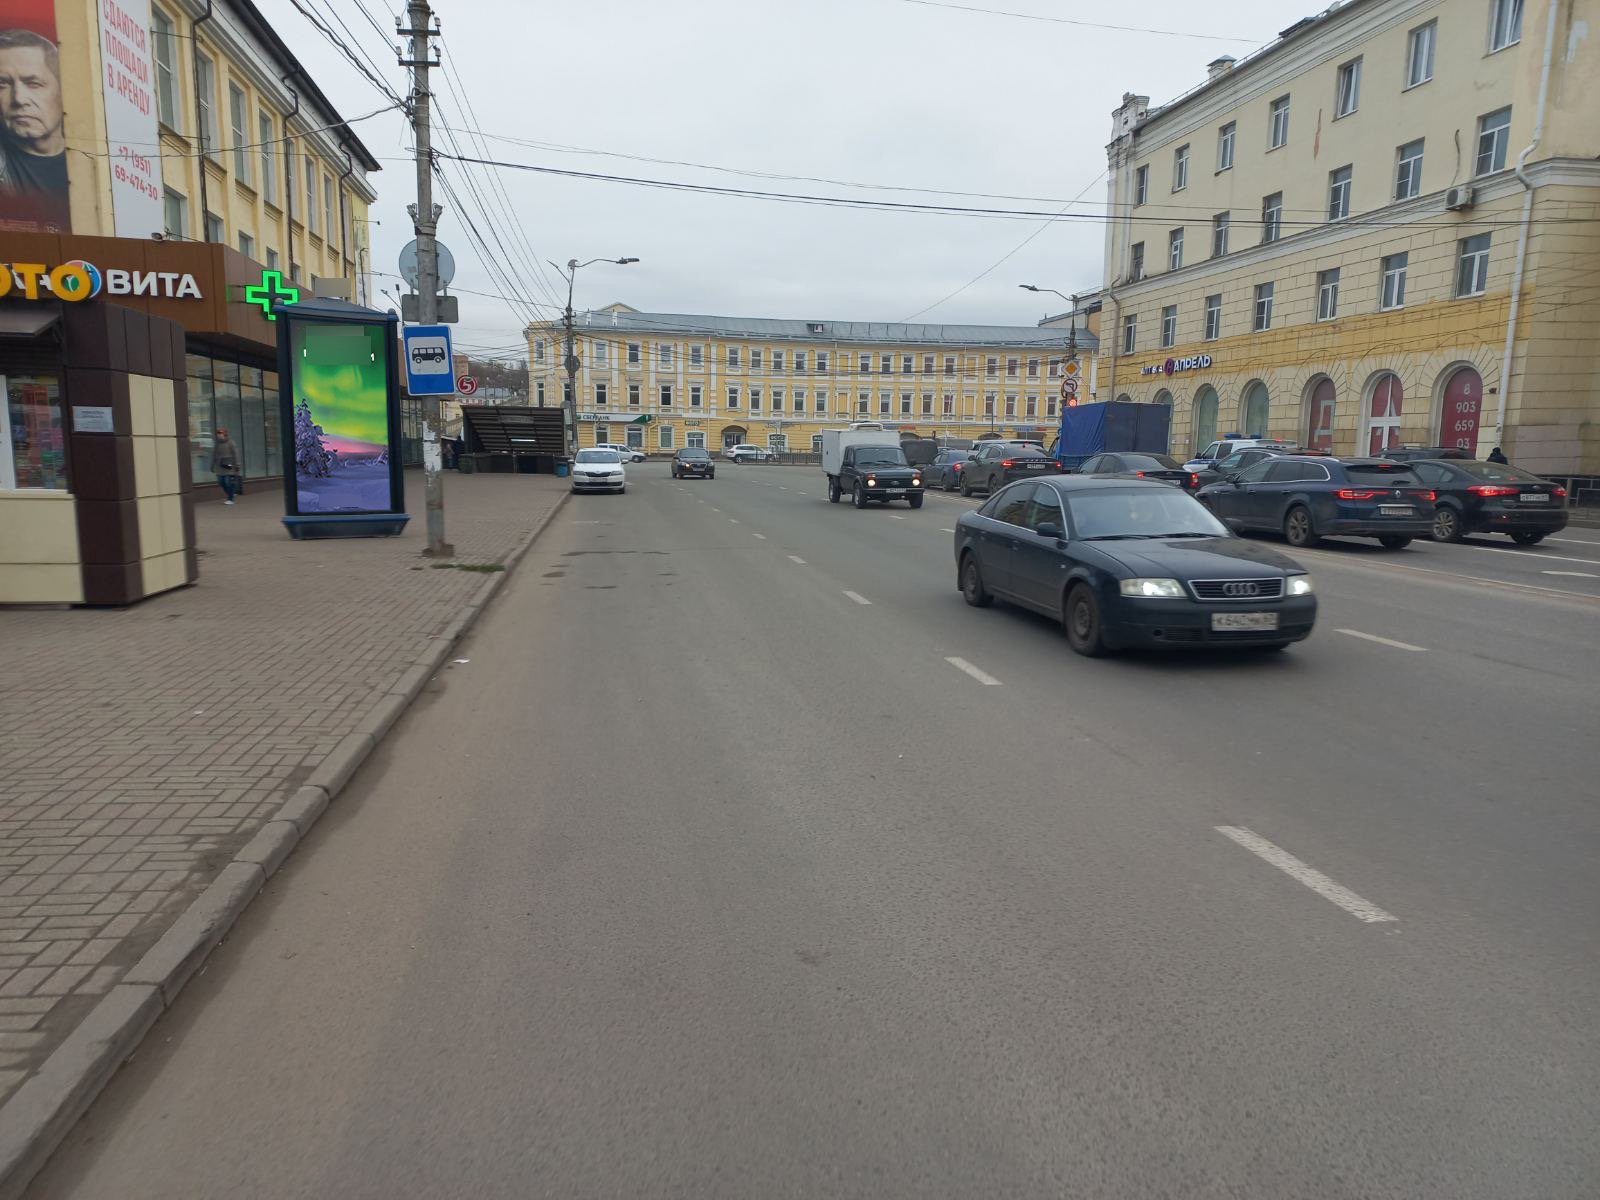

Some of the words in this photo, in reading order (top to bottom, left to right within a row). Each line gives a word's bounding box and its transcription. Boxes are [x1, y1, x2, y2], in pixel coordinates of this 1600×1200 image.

[102, 0, 146, 53] СДАЮТСЯ
[105, 28, 148, 85] ПЛОЩАДИ
[108, 63, 114, 88] В
[117, 71, 150, 116] АРЕНДУ
[118, 145, 129, 161] +7
[131, 149, 151, 177] (951)
[115, 164, 158, 200] 69-474-30
[106, 269, 203, 299] ВИТА
[1463, 383, 1471, 395] 8
[1456, 401, 1476, 413] 903
[1455, 420, 1475, 432] 659
